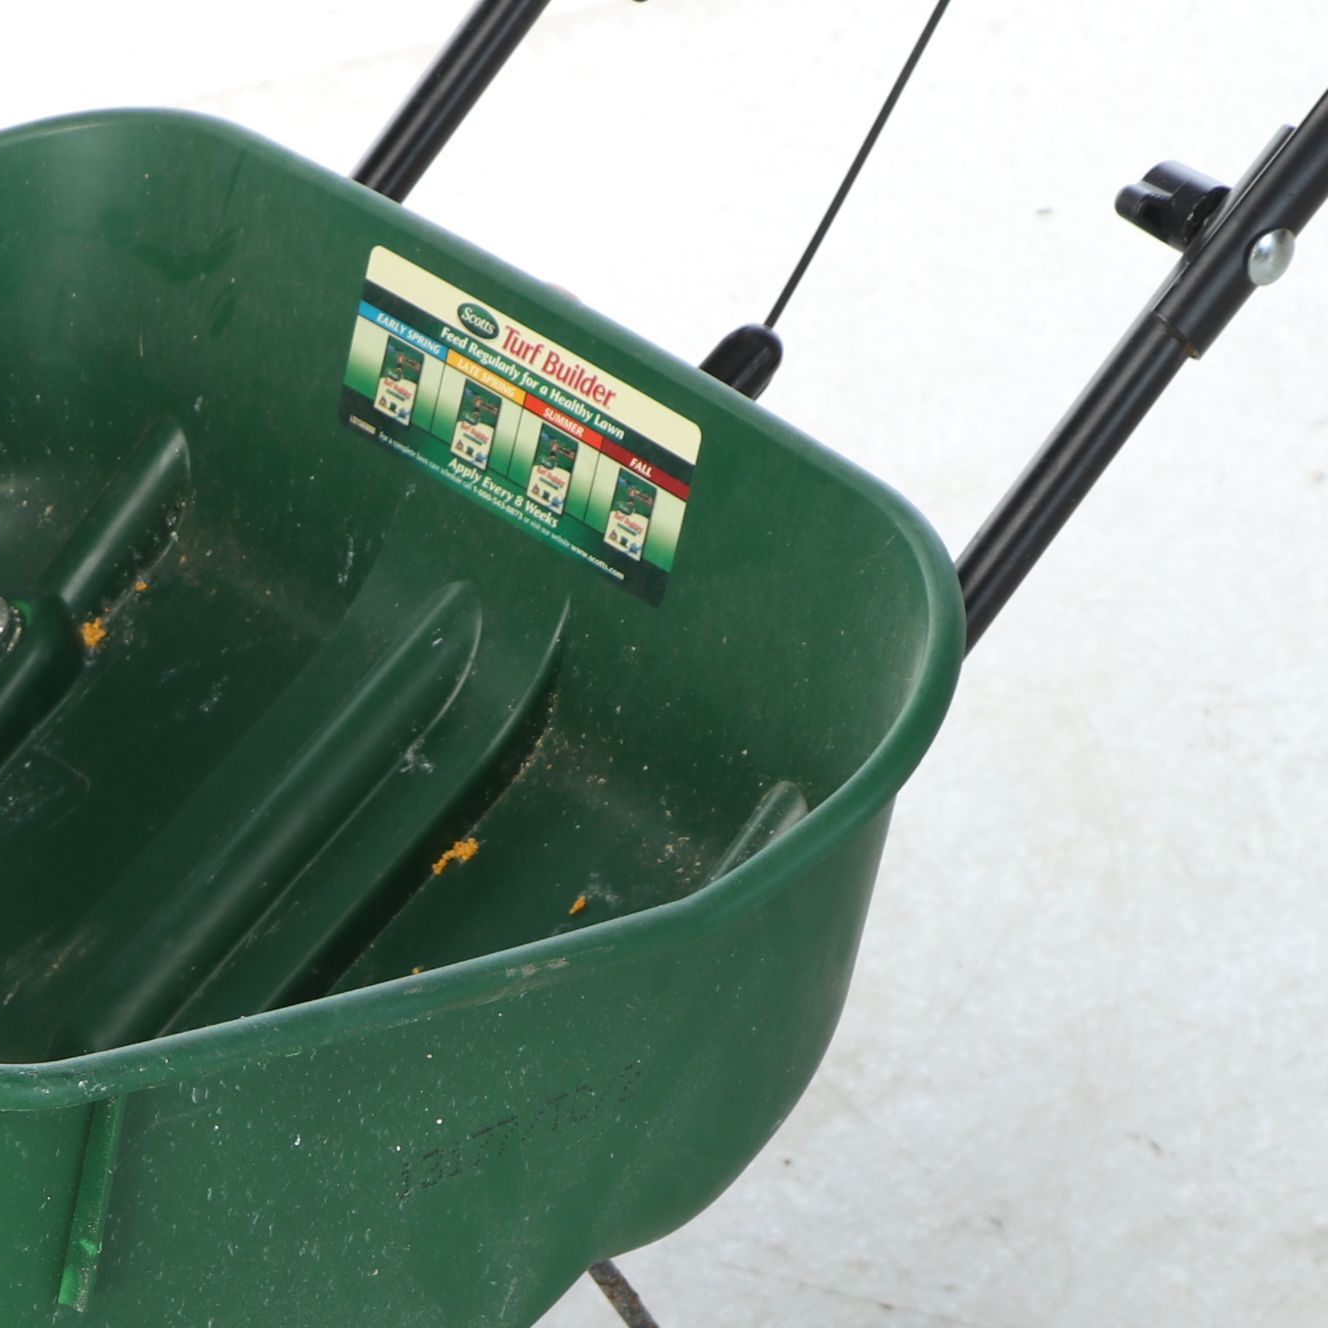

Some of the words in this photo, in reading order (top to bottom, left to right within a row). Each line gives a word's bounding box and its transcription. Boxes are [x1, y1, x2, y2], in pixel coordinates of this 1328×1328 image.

[376, 312, 408, 337] EARLY
[406, 327, 441, 354] SPRING
[460, 306, 495, 335] Scotts
[440, 326, 468, 351] Feed
[468, 341, 528, 383] Regularly
[519, 371, 539, 391] for
[539, 384, 548, 396] a
[549, 387, 593, 423] Healthy
[594, 414, 625, 440] Lawn
[458, 358, 482, 377] LATE
[481, 371, 516, 398] SPRING
[503, 325, 543, 364] Turf
[542, 357, 616, 406] Builder
[543, 406, 584, 437] SUMMER
[629, 457, 653, 477] FALL
[448, 458, 481, 483] Apply
[483, 476, 514, 501] Every
[515, 496, 524, 507] 8
[525, 501, 559, 528] Weeks
